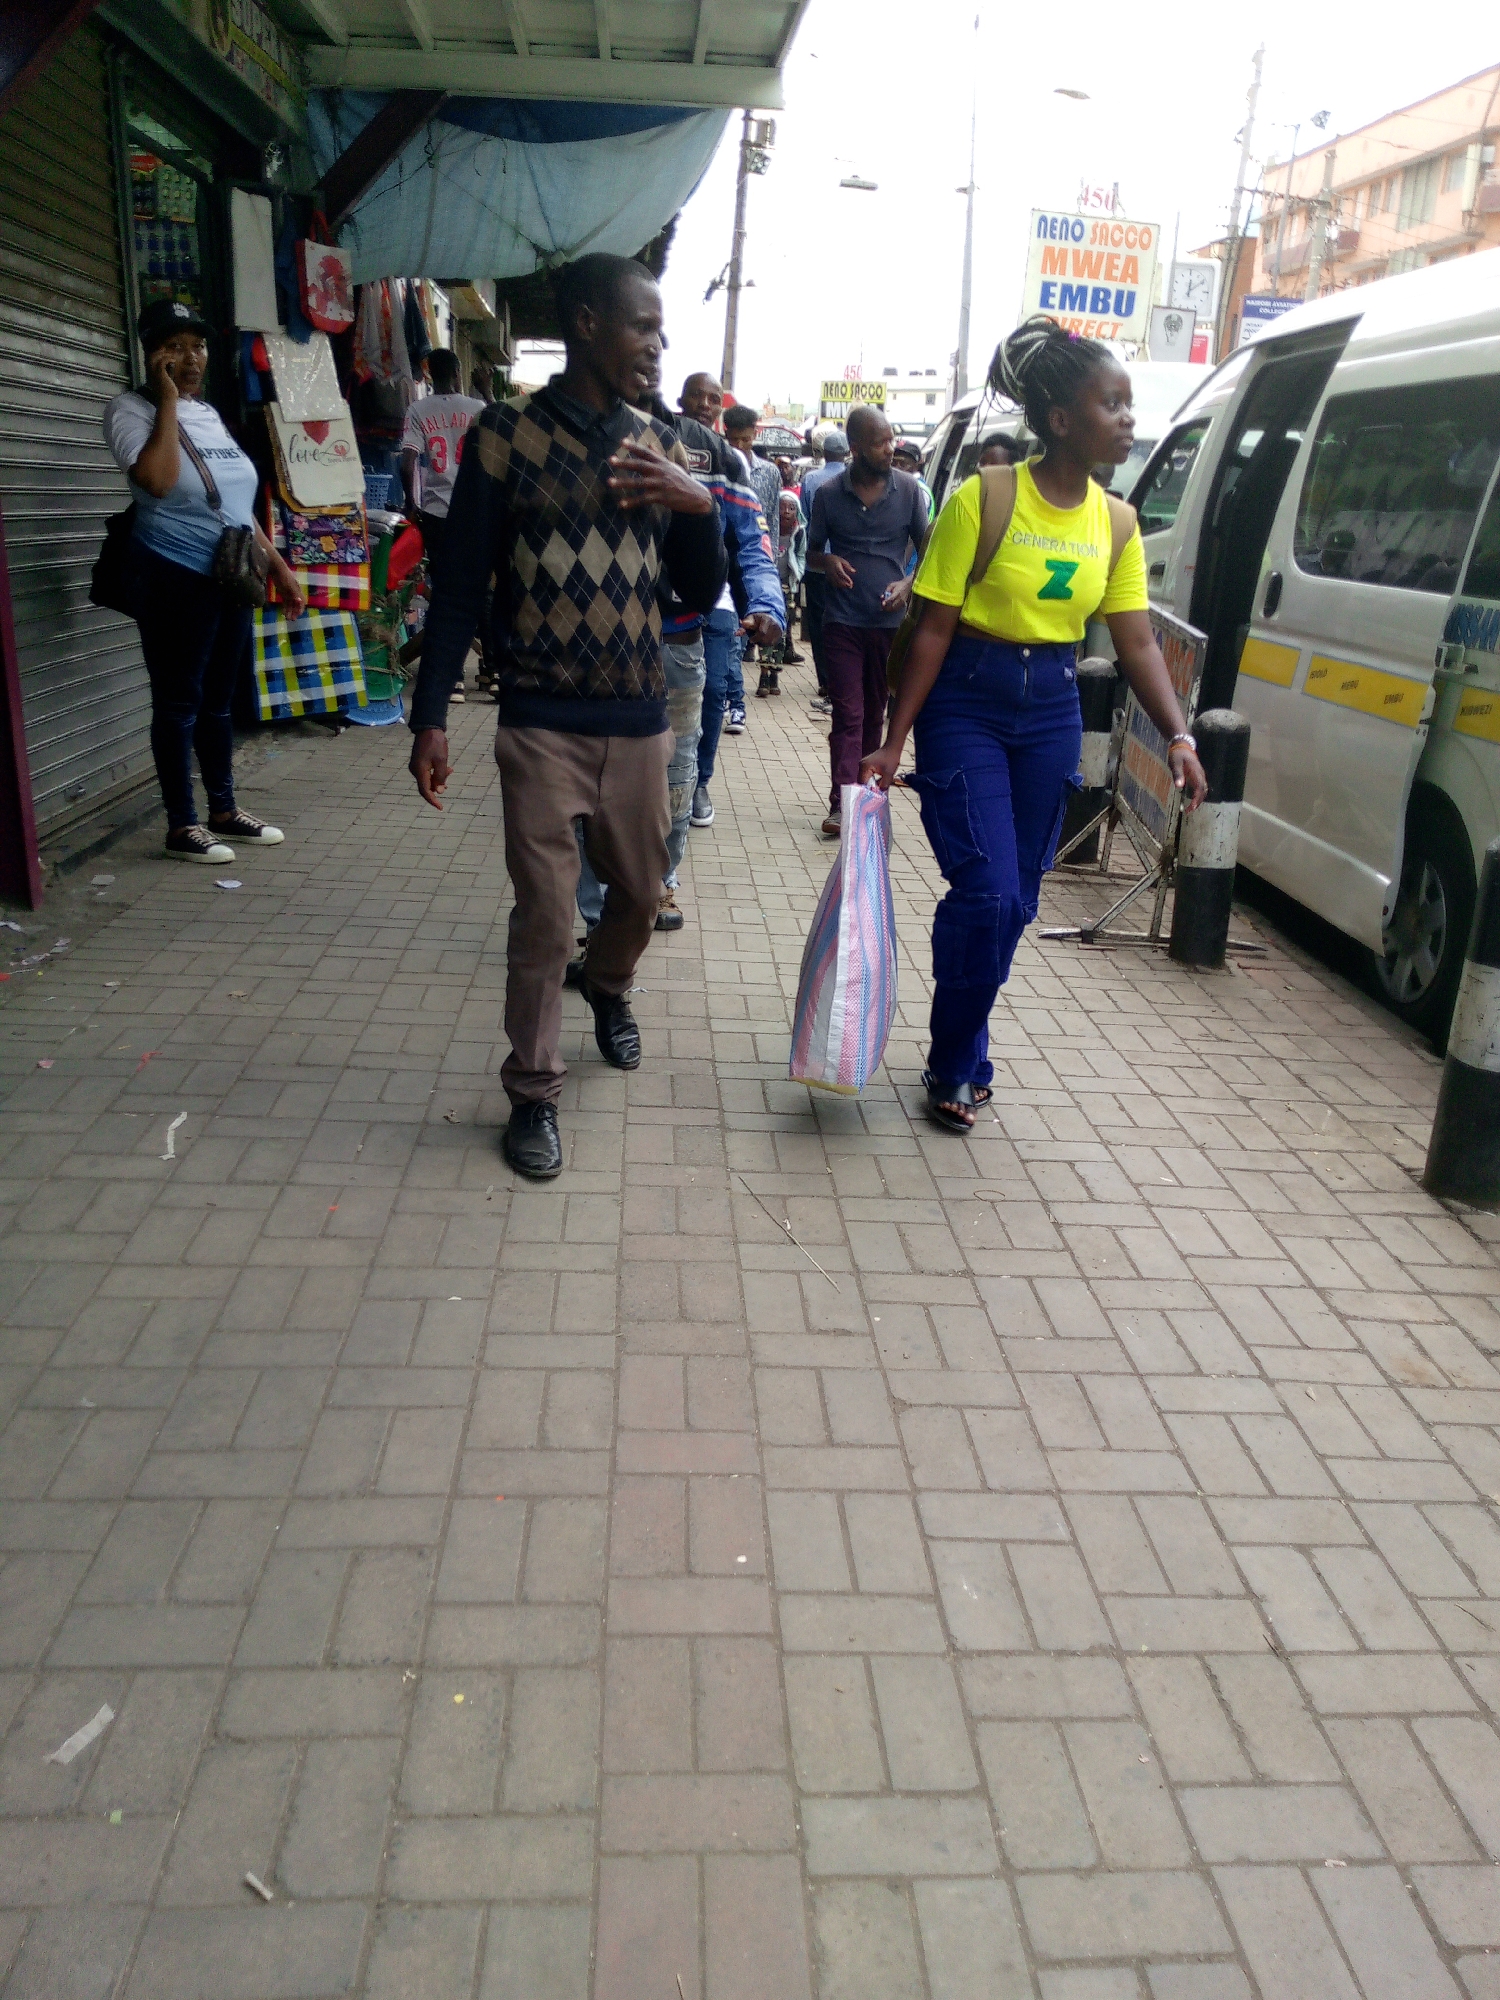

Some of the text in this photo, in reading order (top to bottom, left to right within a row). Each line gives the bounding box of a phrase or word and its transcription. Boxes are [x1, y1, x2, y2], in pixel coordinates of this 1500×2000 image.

[1036, 214, 1153, 251] NENO SACCO
[1040, 245, 1140, 285] MWEA
[1039, 280, 1137, 318] EMBU
[844, 364, 862, 380] 450
[823, 382, 883, 400] NENO SACCO
[1012, 531, 1099, 558] GENERATION
[1036, 558, 1081, 600] Z
[1383, 692, 1405, 705] EMBU
